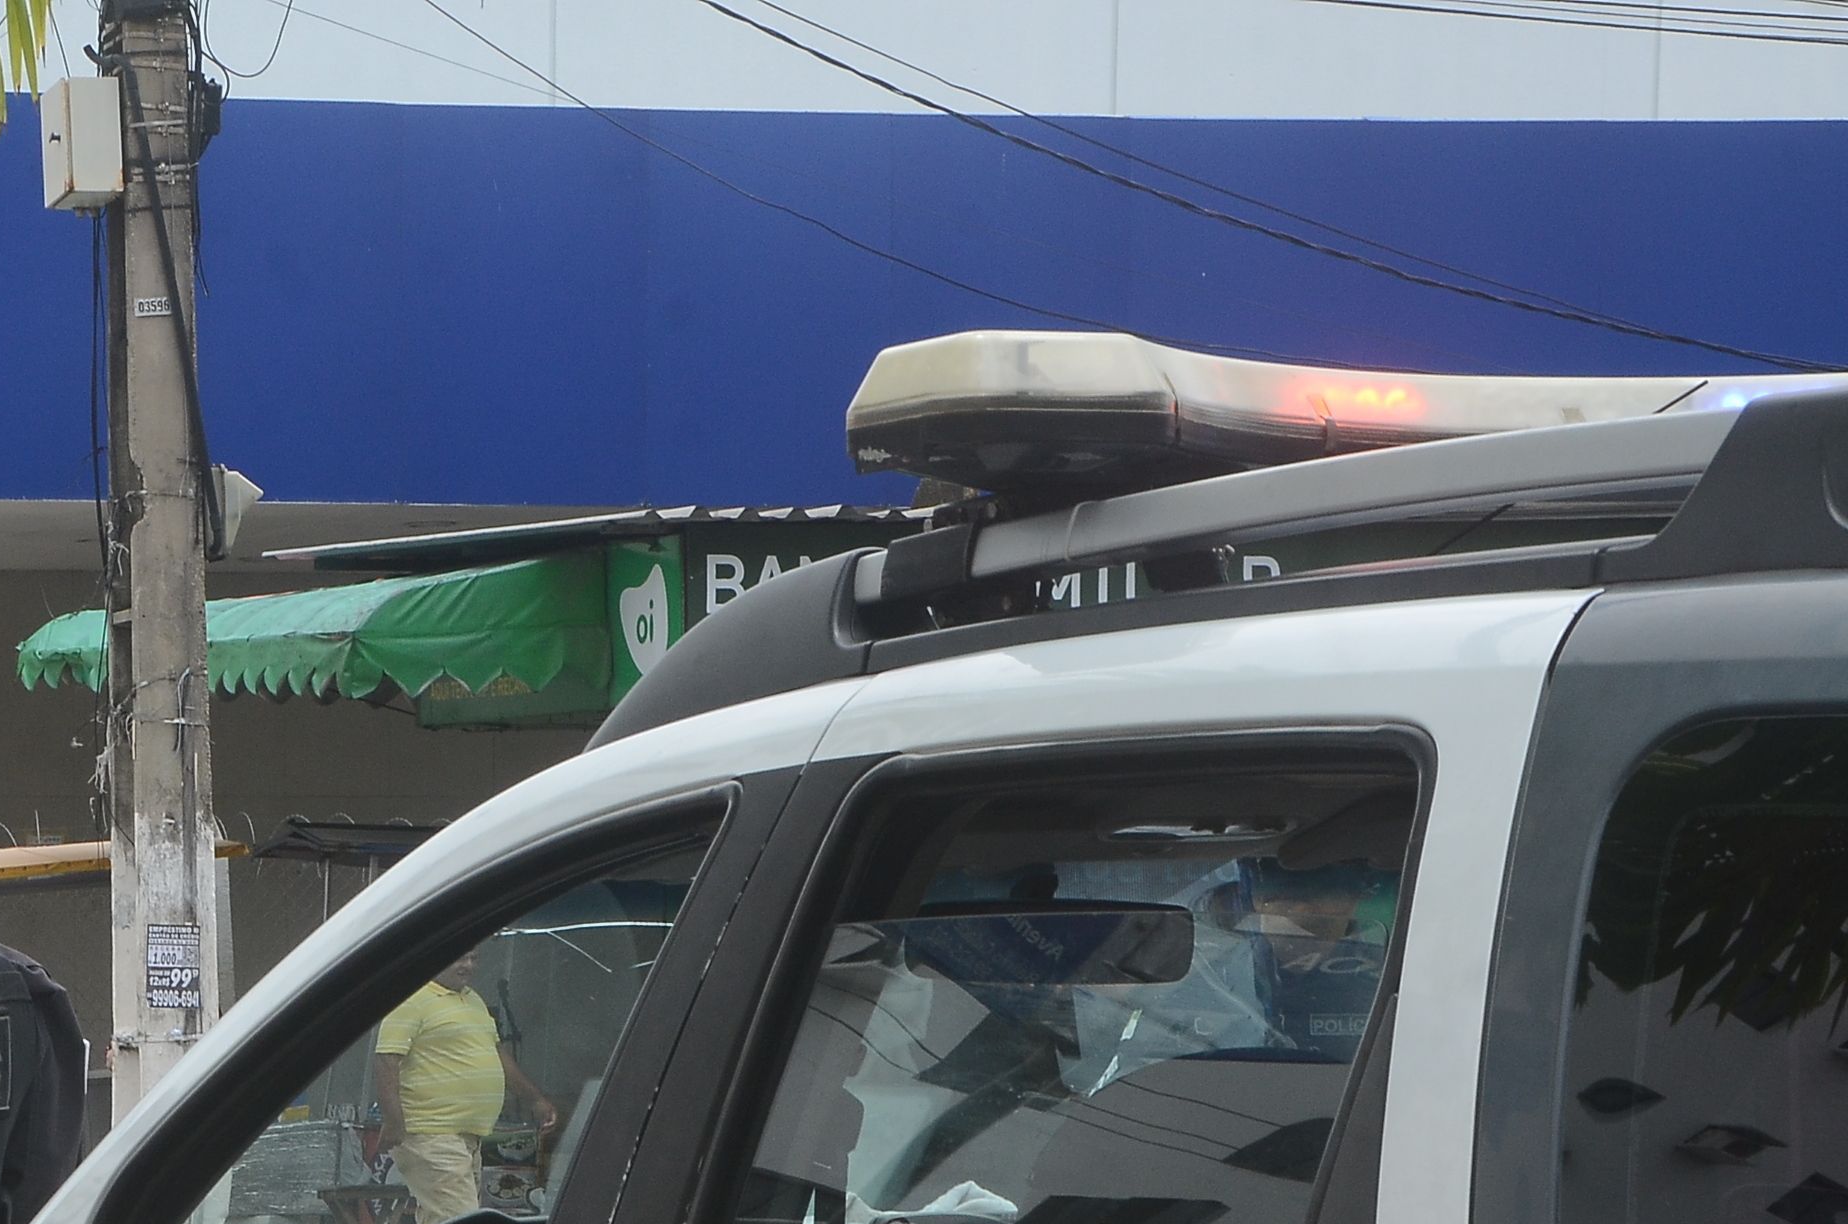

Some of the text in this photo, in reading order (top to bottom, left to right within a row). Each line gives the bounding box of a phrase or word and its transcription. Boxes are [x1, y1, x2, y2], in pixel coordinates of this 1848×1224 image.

[138, 300, 170, 312] 03596
[707, 554, 812, 614] BA
[637, 599, 653, 645] oi
[153, 953, 177, 965] 1.000
